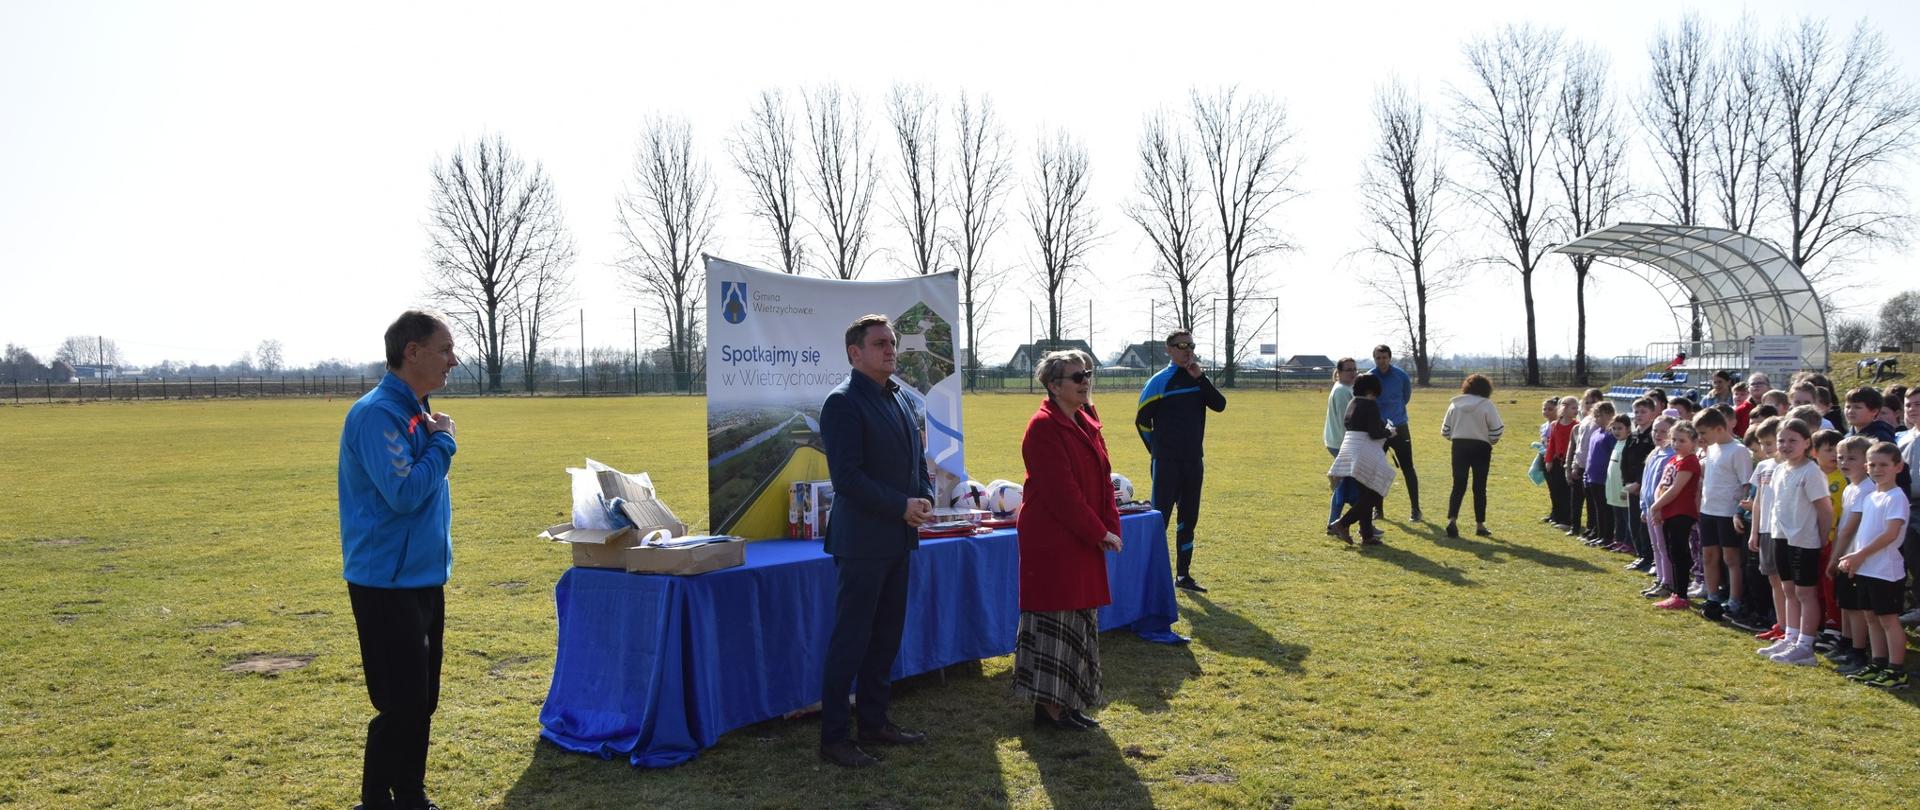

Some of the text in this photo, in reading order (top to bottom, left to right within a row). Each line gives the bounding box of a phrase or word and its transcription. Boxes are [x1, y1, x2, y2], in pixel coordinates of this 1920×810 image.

[752, 290, 781, 302] Gmina
[721, 345, 821, 367] Spotkajmy się
[722, 373, 736, 387] w
